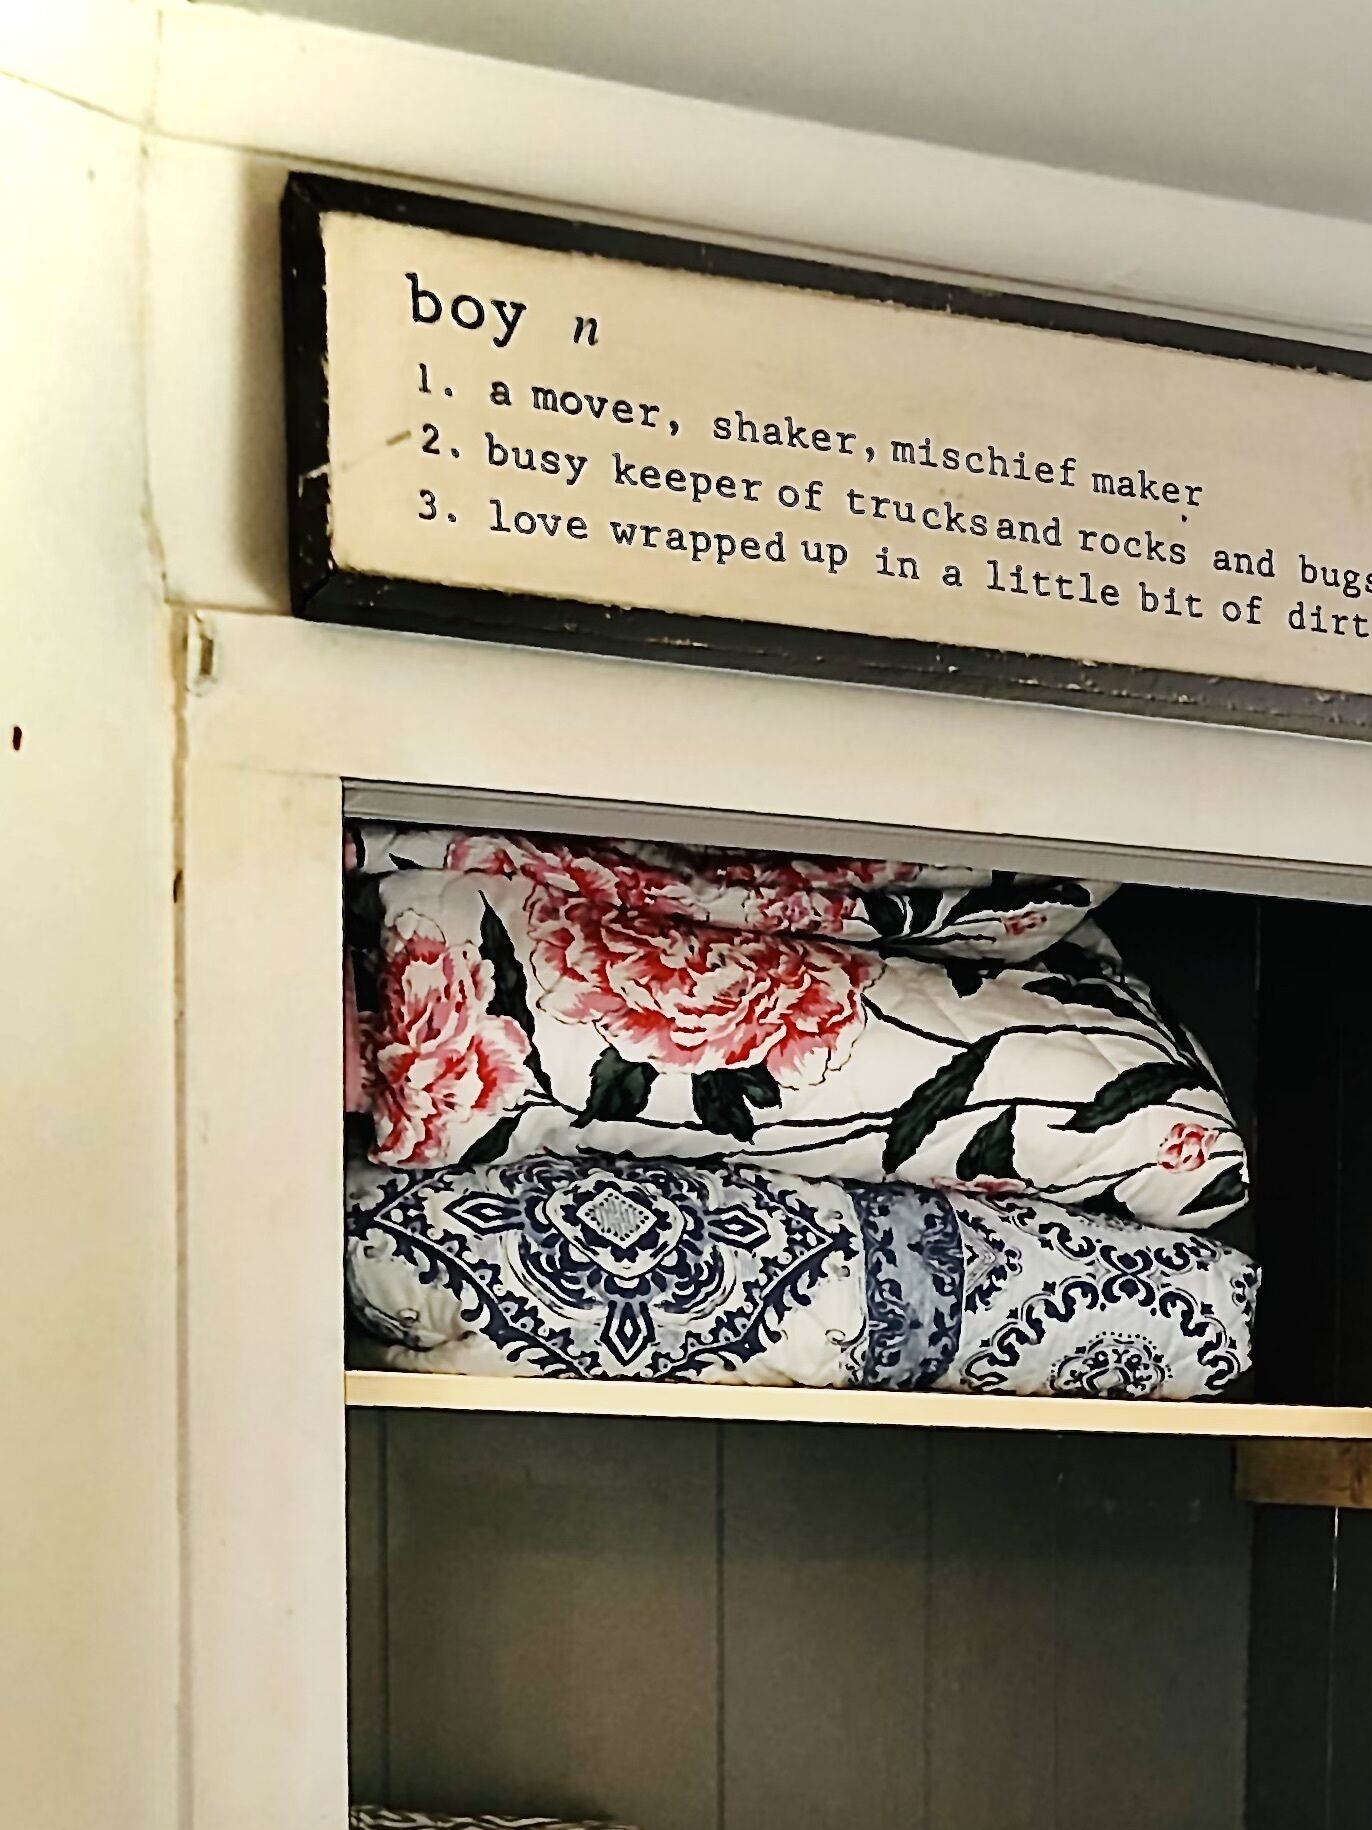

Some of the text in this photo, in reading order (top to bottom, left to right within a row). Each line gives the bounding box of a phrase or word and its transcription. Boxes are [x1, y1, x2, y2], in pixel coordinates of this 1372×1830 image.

[405, 273, 599, 347] boy n
[419, 363, 1203, 507] 1. a mover, shaker, mischief maker
[422, 424, 460, 459] 2.
[485, 432, 588, 485] busy
[612, 453, 762, 503] keeper
[779, 480, 823, 512] of
[1078, 530, 1187, 564] rocks
[1213, 549, 1275, 584] and
[418, 490, 1370, 639] 3. love wrapped up in a little bit of dirt
